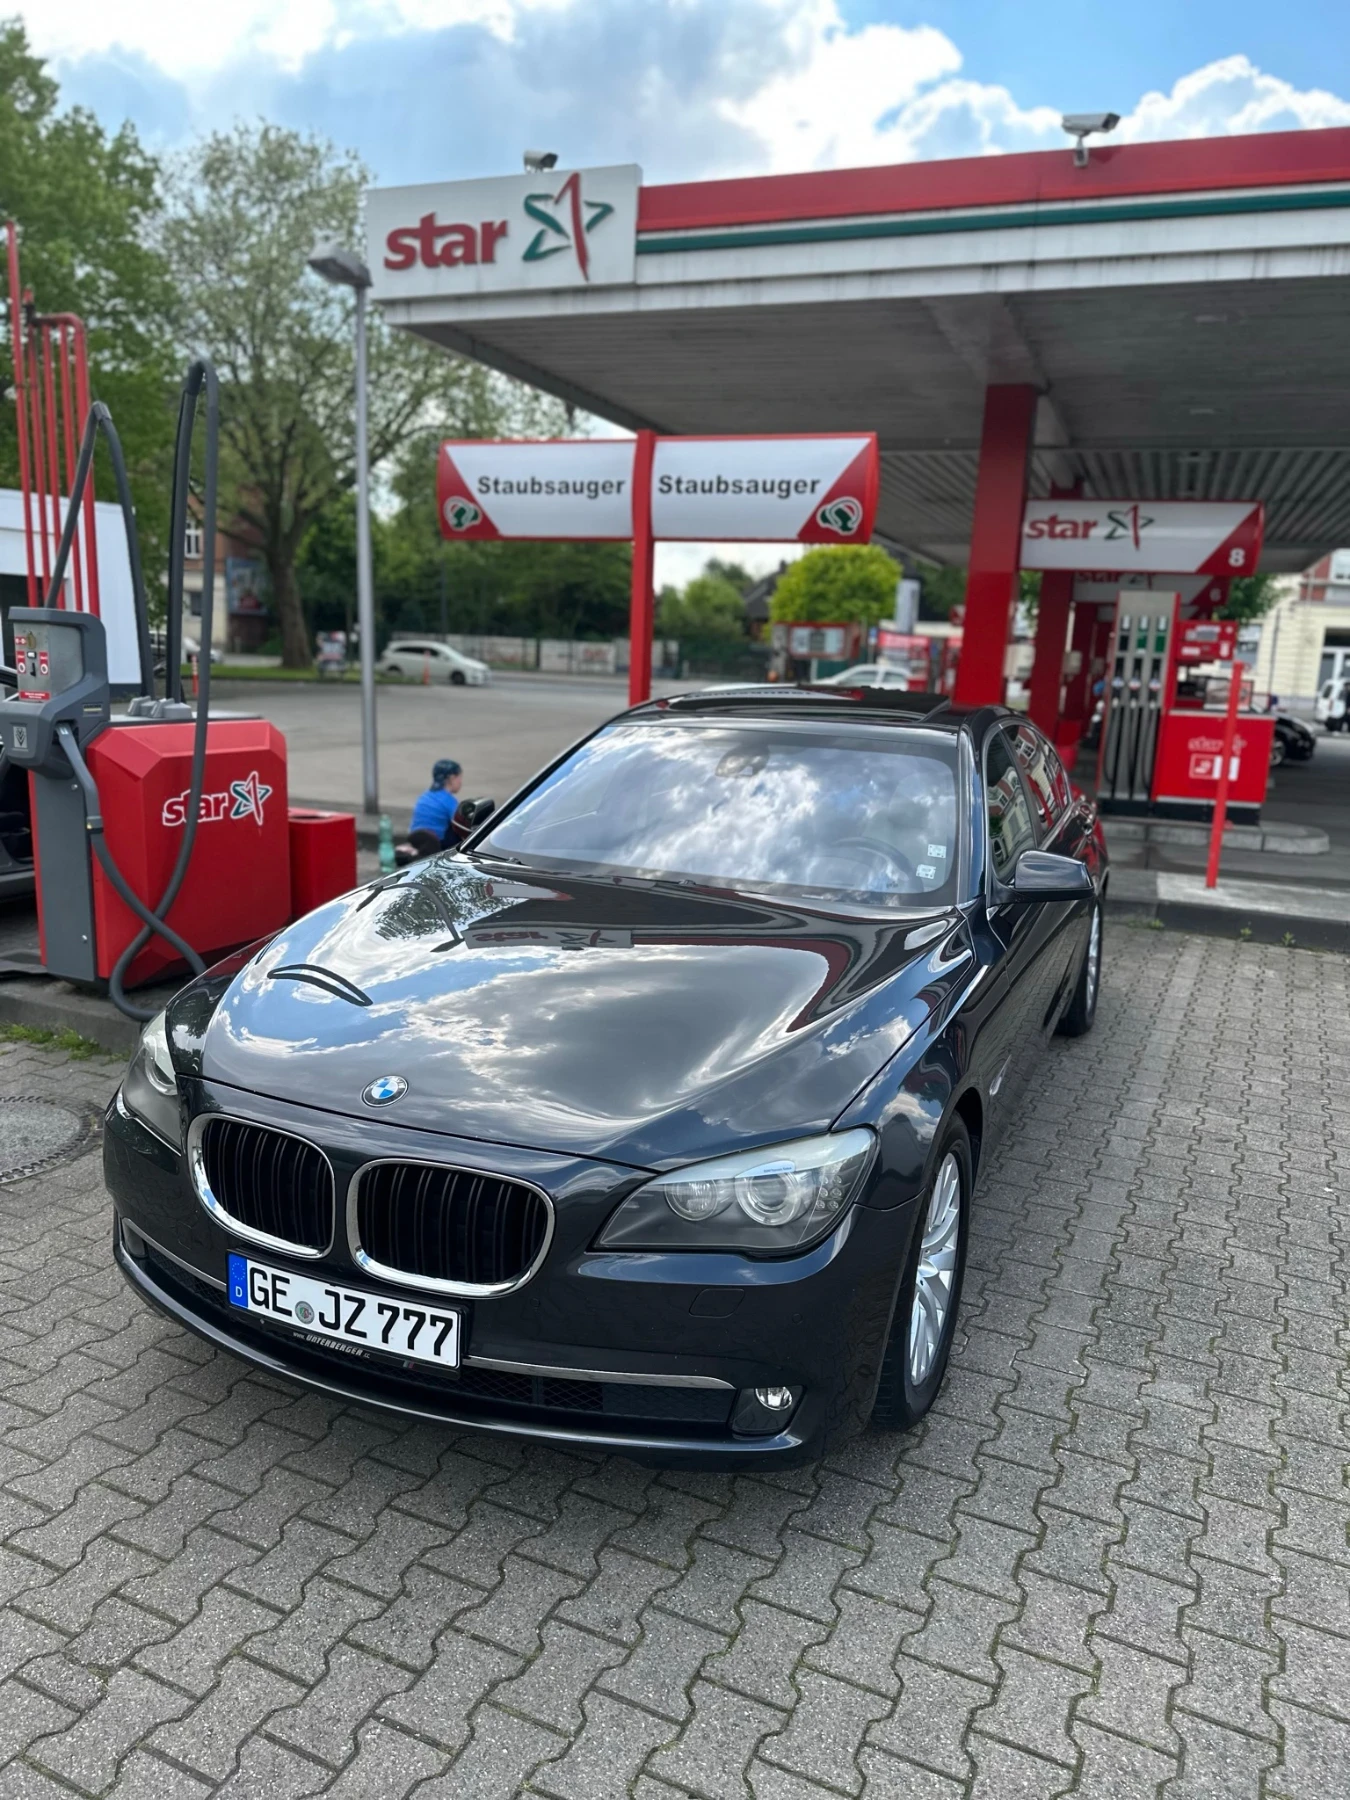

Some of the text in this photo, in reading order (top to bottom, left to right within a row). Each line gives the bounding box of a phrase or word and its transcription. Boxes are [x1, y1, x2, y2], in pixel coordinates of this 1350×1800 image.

[384, 212, 508, 271] star
[477, 475, 625, 499] Staubsauger
[658, 475, 820, 499] Staubsauger
[1026, 513, 1098, 540] star
[1228, 547, 1246, 568] 8
[235, 1285, 243, 1298] D
[250, 1266, 454, 1357] GE JZ 777
